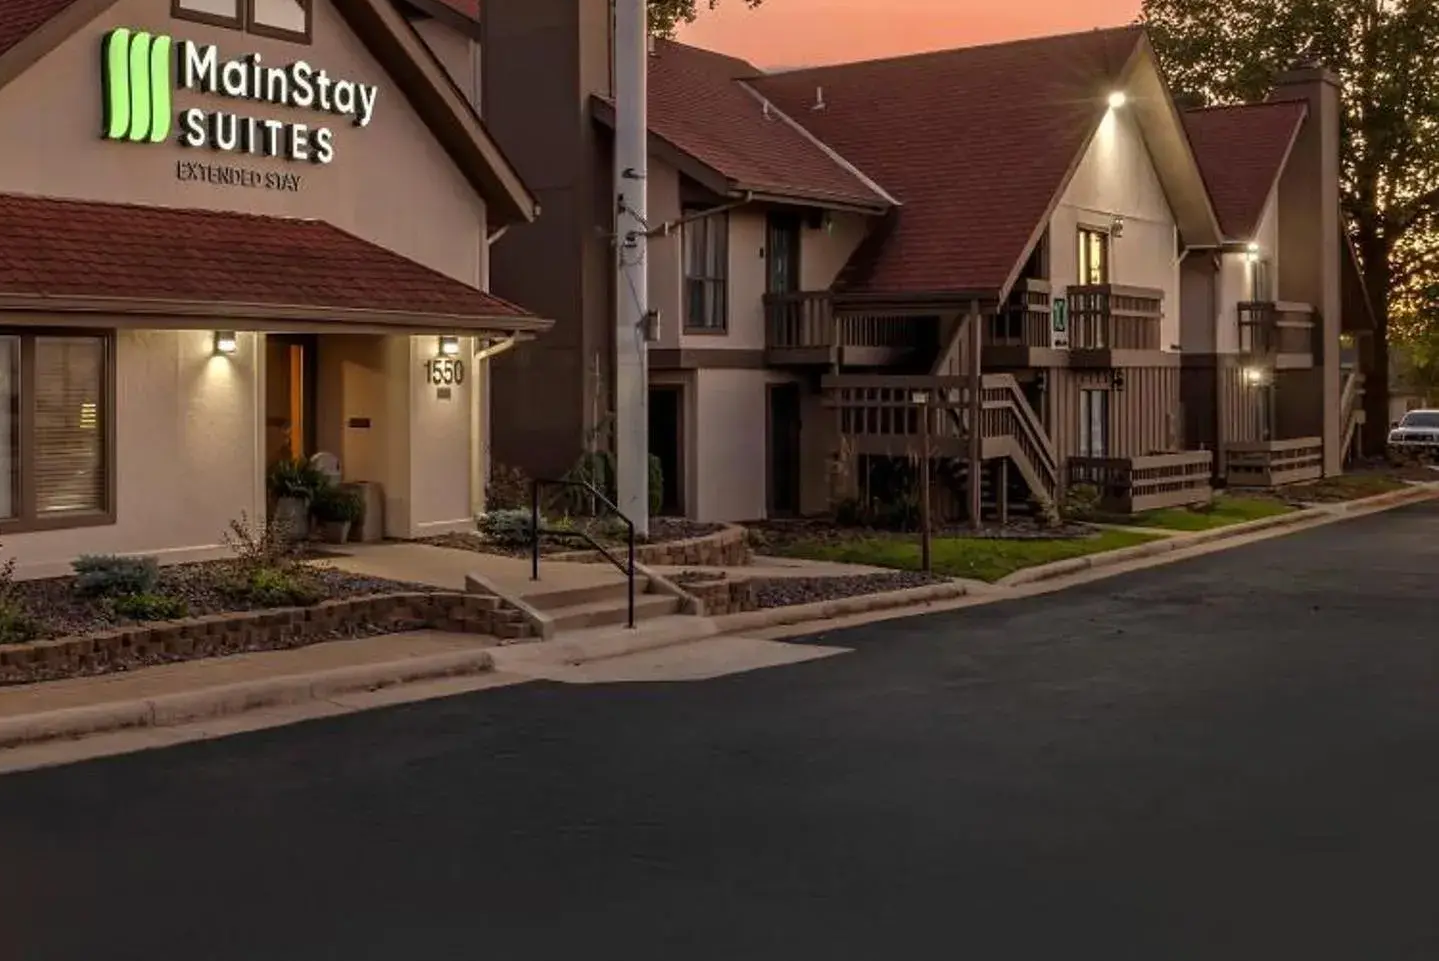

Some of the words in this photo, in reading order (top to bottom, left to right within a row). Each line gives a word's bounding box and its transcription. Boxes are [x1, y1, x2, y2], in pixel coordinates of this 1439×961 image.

[180, 40, 377, 127] MainStay
[181, 108, 334, 164] SUITES
[176, 160, 261, 188] EXTENDED
[265, 171, 301, 192] STAY
[424, 359, 464, 386] 1550
